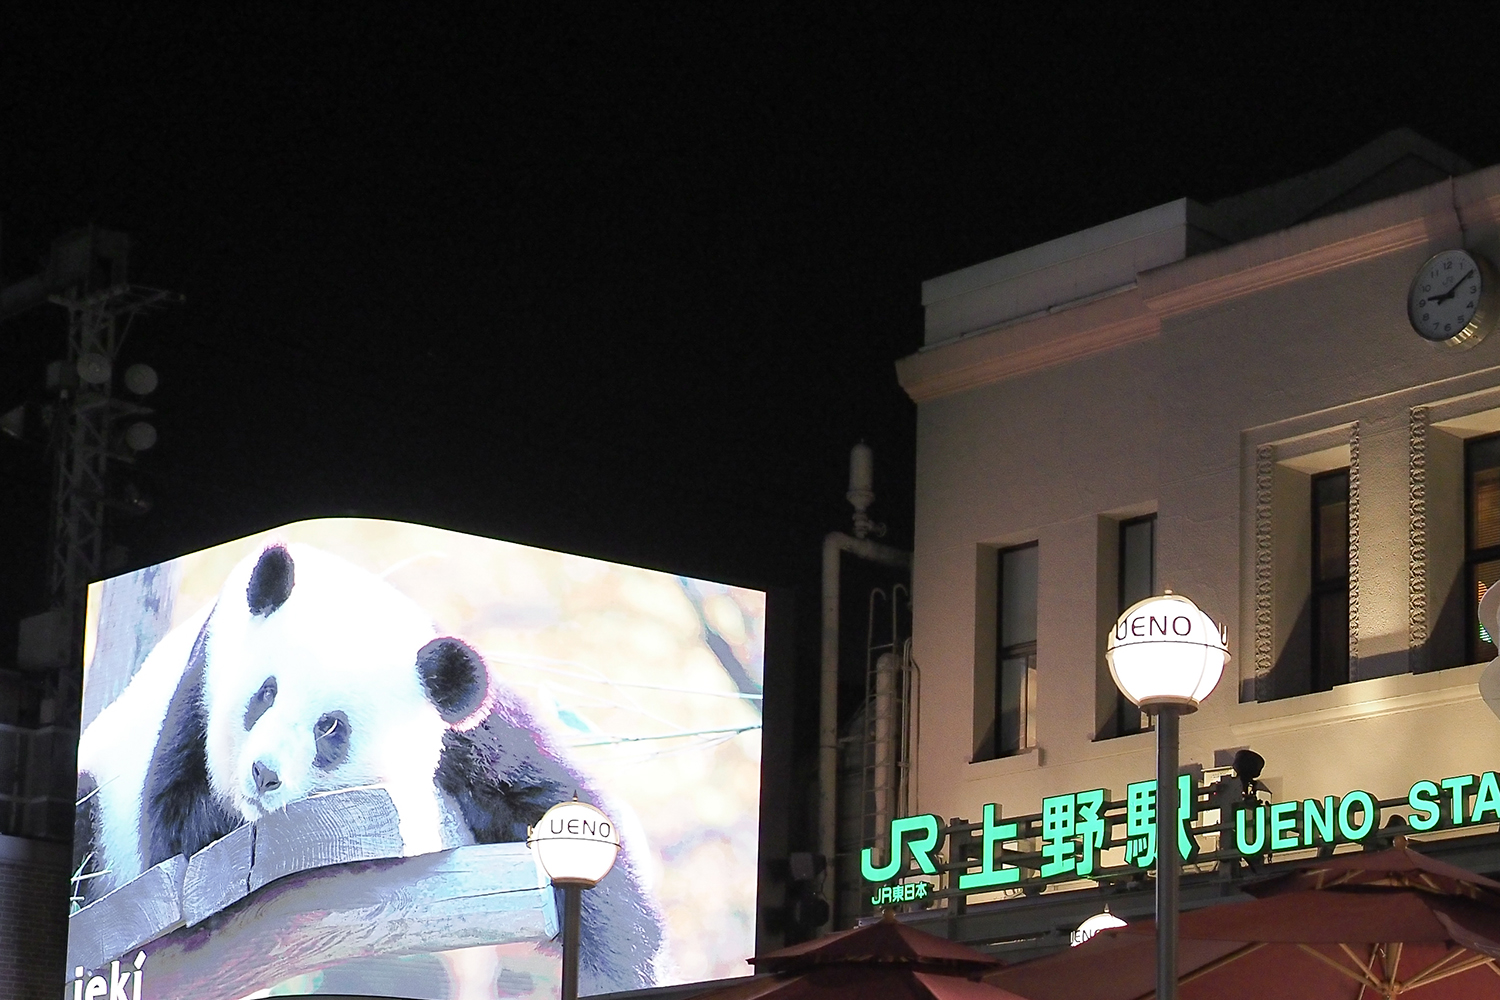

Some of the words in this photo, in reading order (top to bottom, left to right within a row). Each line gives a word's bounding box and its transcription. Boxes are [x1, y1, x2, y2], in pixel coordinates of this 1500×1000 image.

[1444, 261, 1453, 270] 12
[1431, 270, 1439, 278] 11
[1422, 284, 1431, 293] 10
[1470, 285, 1477, 294] 3
[1419, 299, 1426, 308] 9
[1466, 301, 1474, 309] 4
[1423, 313, 1430, 321] 8
[1457, 315, 1464, 324] 5
[1433, 322, 1440, 331] 7
[1444, 323, 1452, 332] 6
[1115, 615, 1192, 641] UENO
[1235, 789, 1376, 856] UENO
[550, 818, 611, 838] UENO
[860, 813, 939, 883] JR
[958, 773, 1194, 890] 上野駅
[870, 882, 929, 906] JR東日本
